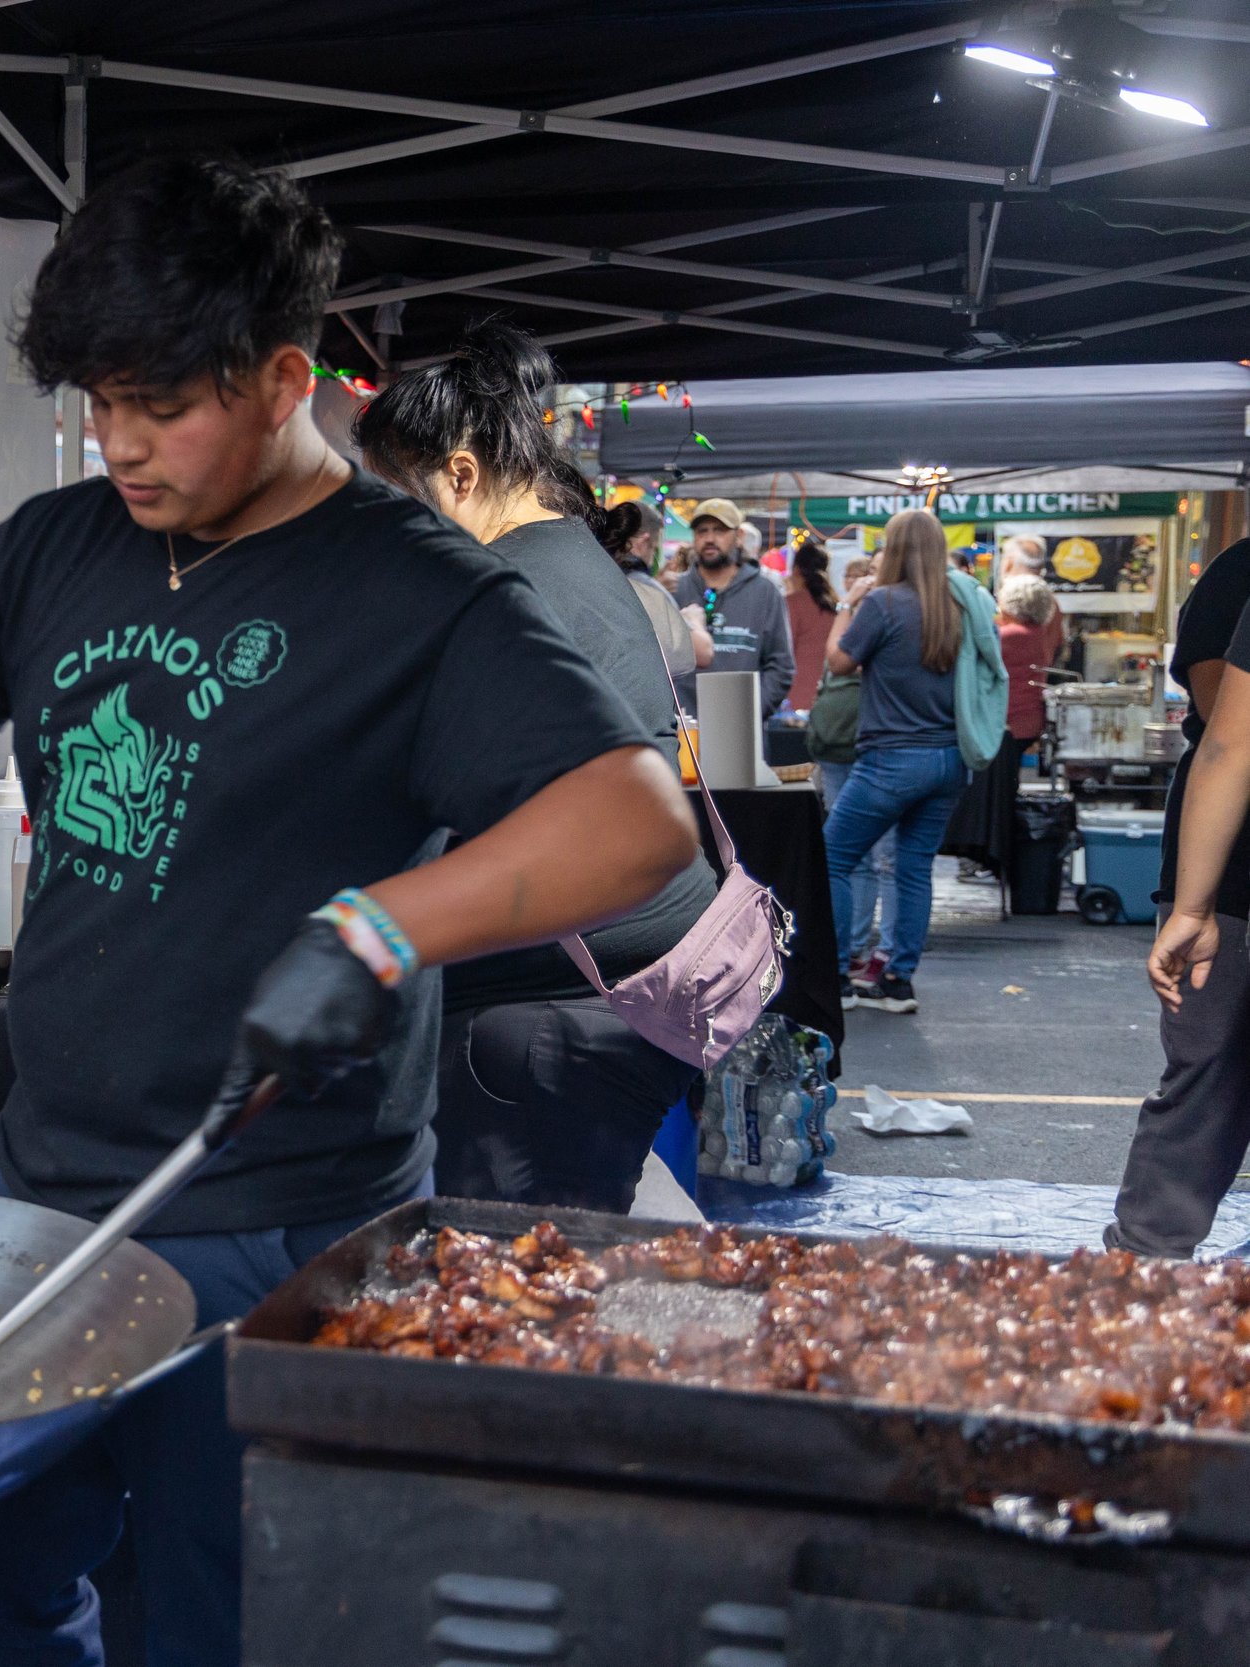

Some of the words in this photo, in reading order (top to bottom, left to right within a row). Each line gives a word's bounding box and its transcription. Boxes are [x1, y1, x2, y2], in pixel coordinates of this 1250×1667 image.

[993, 492, 1120, 513] KITCHEN
[54, 624, 224, 720] CHINO'S
[150, 742, 200, 902] STREET
[57, 852, 124, 892] FOOD
